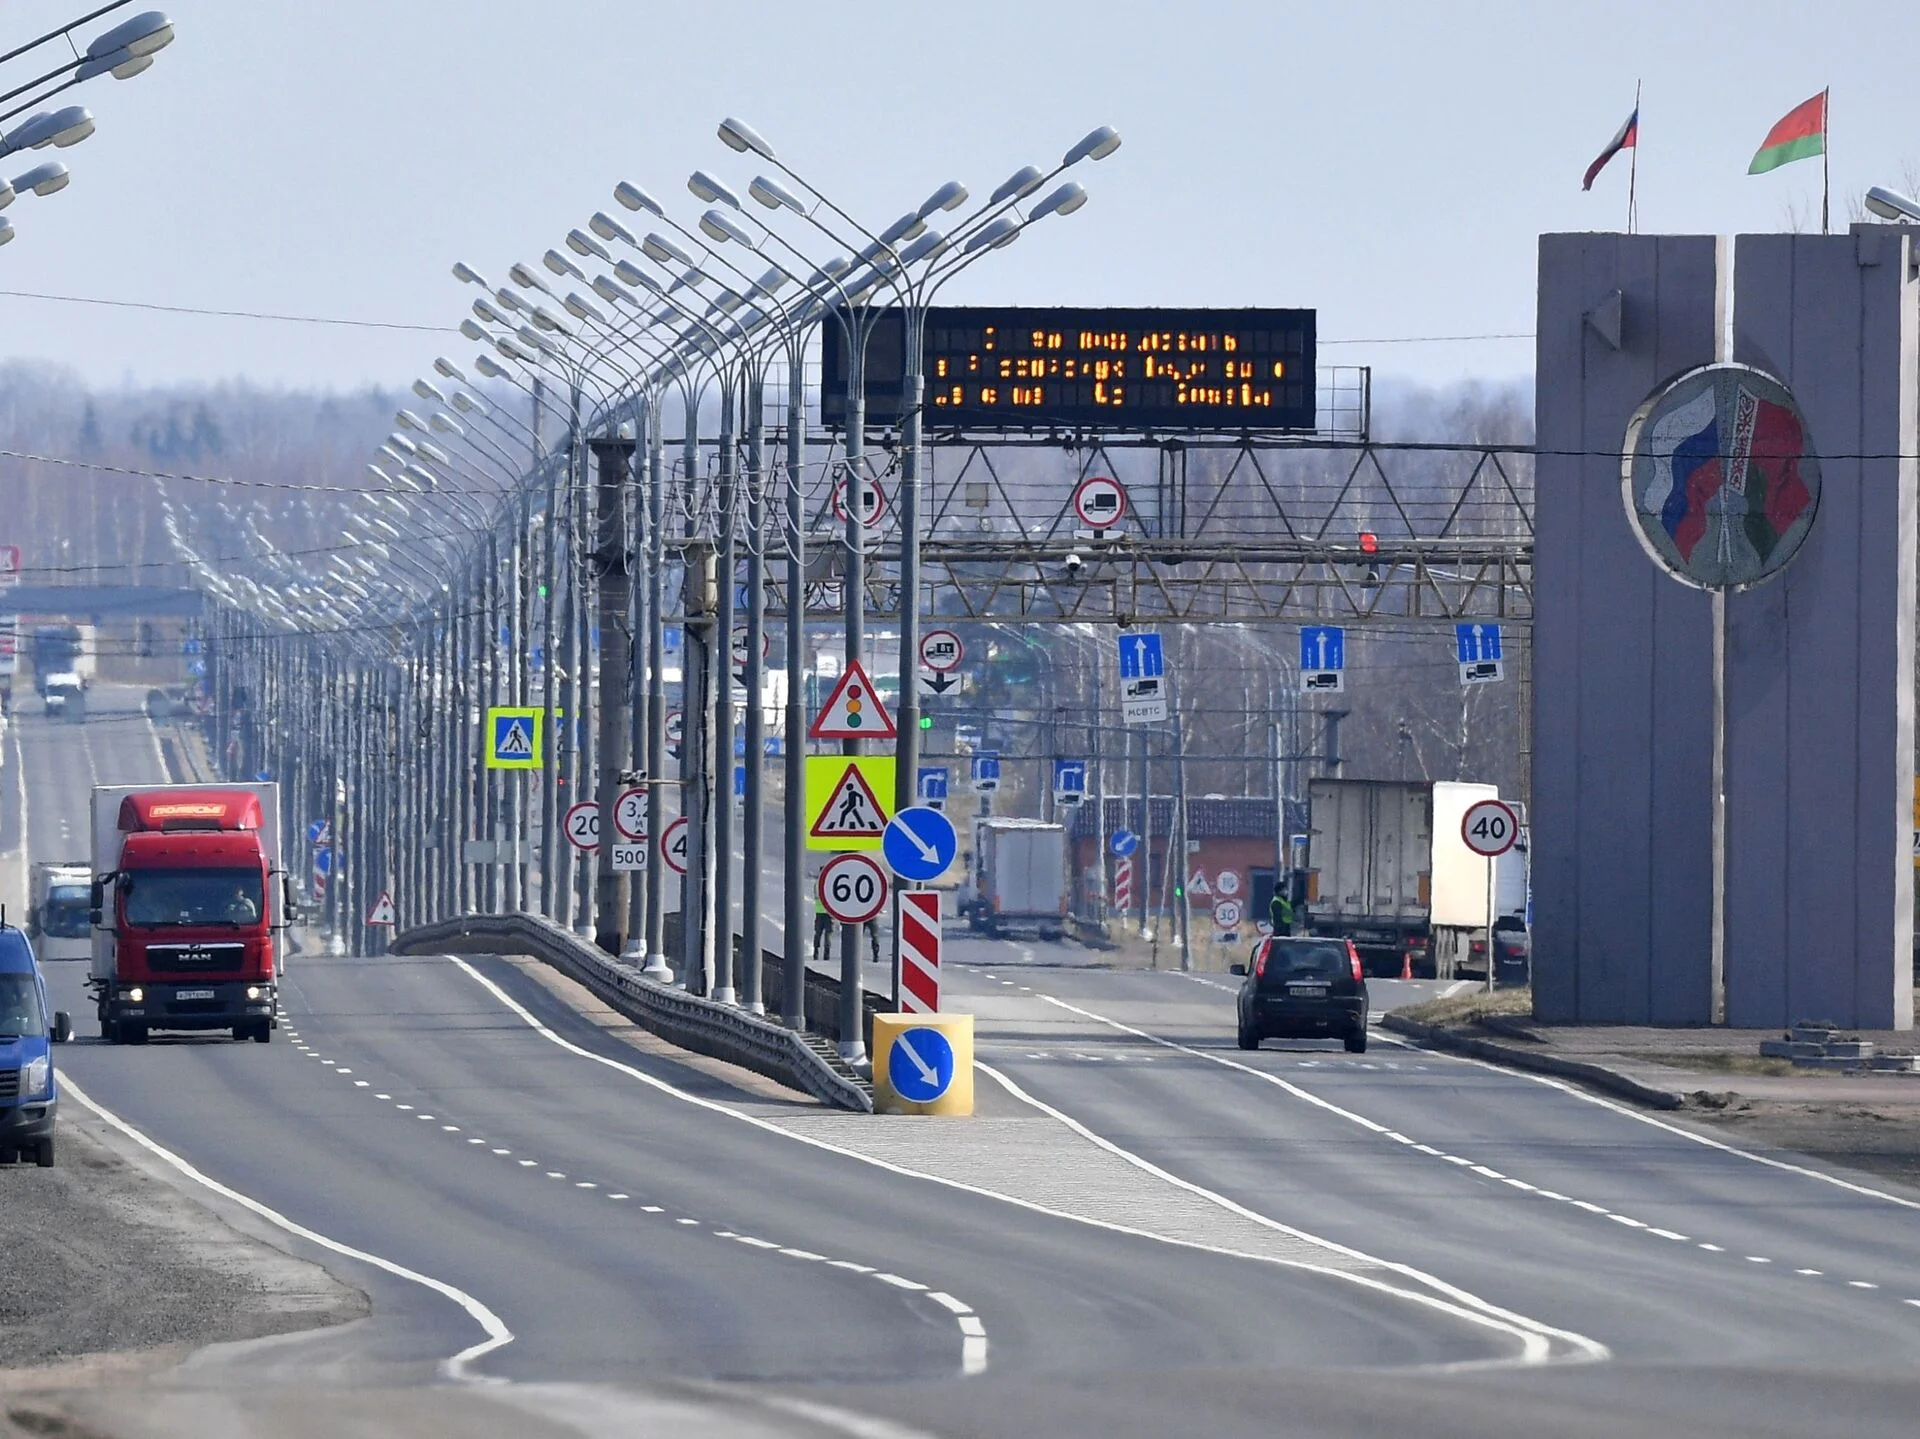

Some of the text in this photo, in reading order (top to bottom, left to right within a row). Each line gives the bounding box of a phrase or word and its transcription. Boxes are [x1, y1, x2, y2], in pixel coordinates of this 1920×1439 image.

[1471, 816, 1506, 839] 40
[614, 850, 646, 864] 500
[832, 873, 875, 903] 60
[1219, 908, 1235, 920] 30
